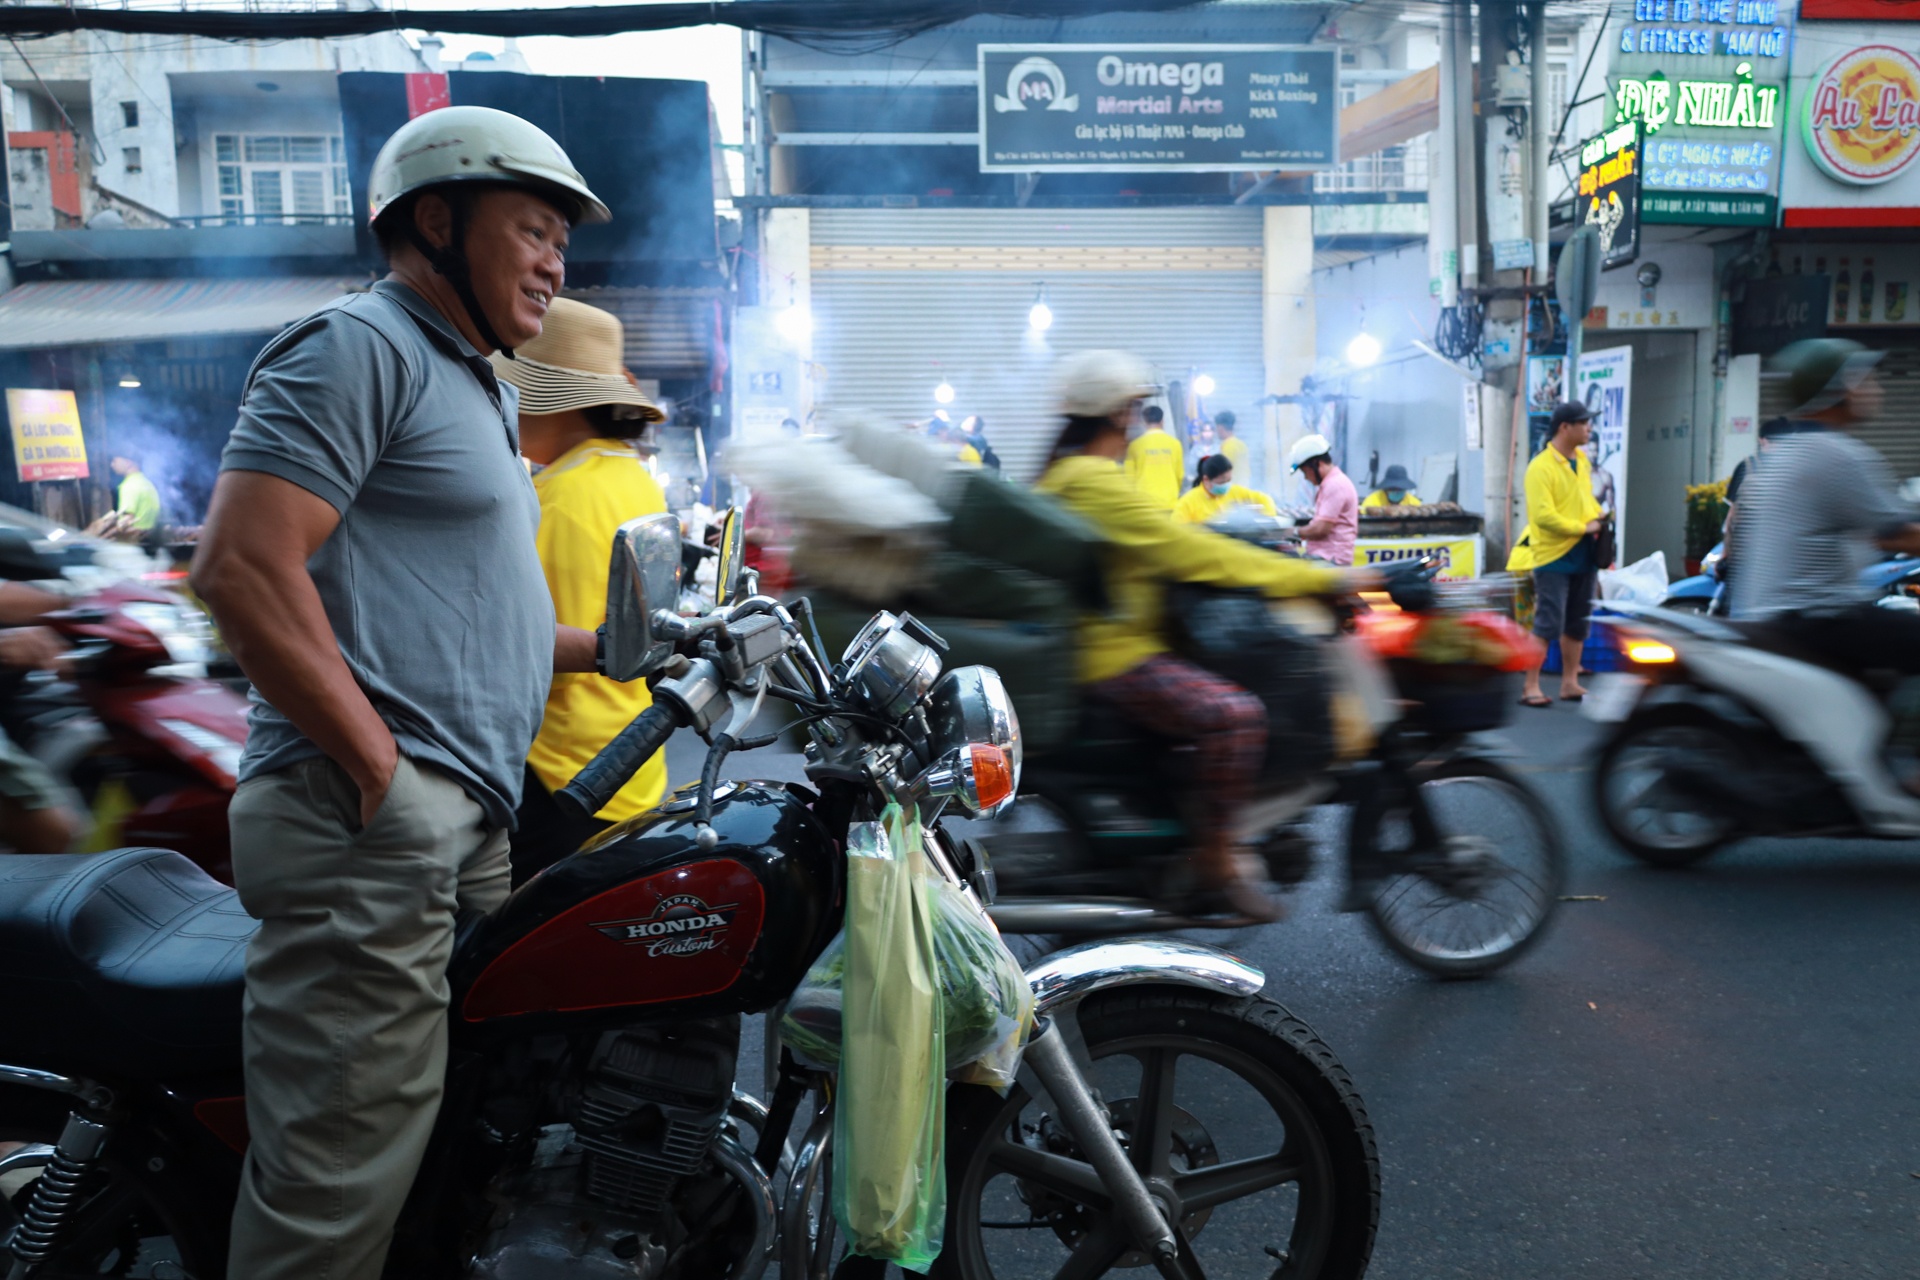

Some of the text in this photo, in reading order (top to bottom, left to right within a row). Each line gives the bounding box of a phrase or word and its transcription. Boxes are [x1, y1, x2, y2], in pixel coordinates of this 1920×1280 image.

[1621, 27, 1635, 52] &
[1639, 28, 1712, 55] FITNESS
[1097, 55, 1223, 95] Omega
[1249, 73, 1281, 86] Muay
[1097, 95, 1223, 114] Martial Arts
[1249, 90, 1318, 104] Kick Boxing
[1813, 76, 1920, 134] Âu Lạ
[1249, 107, 1278, 119] MMA
[1075, 124, 1093, 139] Câu
[1094, 124, 1108, 141] lạc
[1109, 124, 1122, 141] bộ
[1136, 124, 1162, 141] Thuật
[1163, 125, 1185, 139] MMA
[1192, 125, 1223, 141] Omega
[1224, 124, 1245, 138] Club
[661, 897, 699, 912] JAPAN
[627, 913, 727, 938] HONDA
[646, 936, 726, 957] Custom
